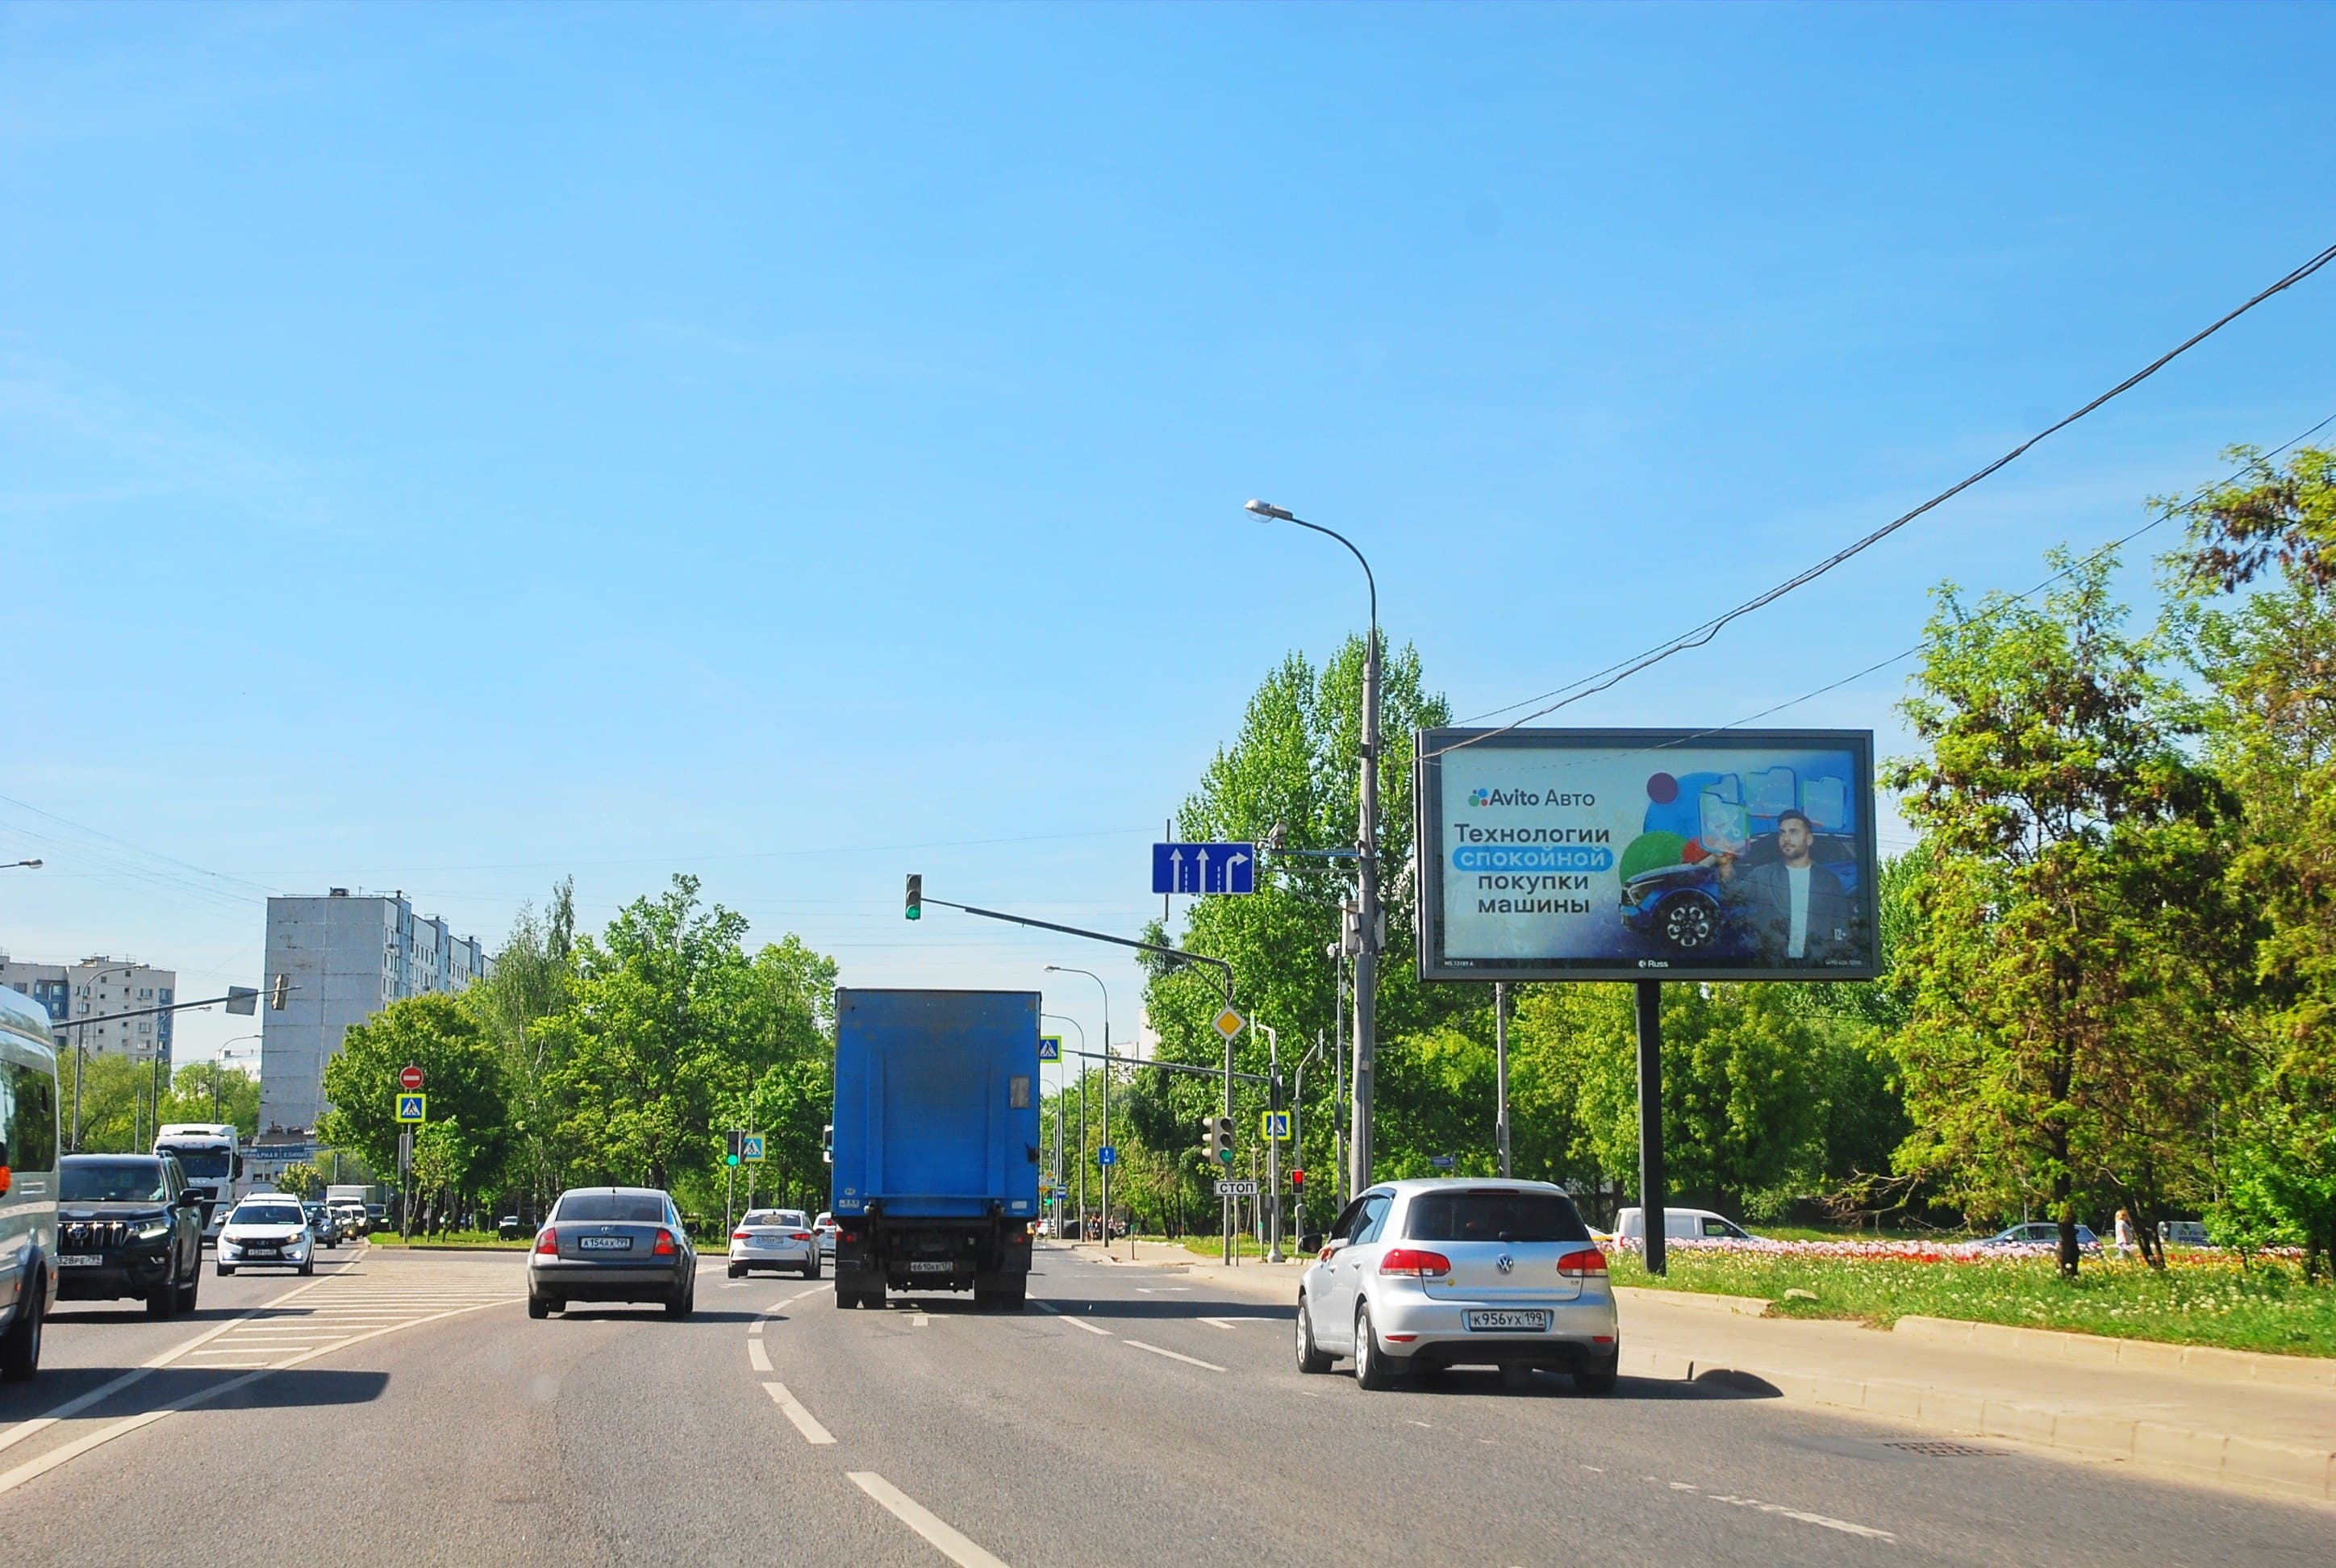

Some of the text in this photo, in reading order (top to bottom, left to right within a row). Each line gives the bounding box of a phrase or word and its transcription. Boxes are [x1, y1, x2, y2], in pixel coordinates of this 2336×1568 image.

[1490, 789, 1596, 807] Avito Авто
[1454, 823, 1610, 843] Технологии
[1460, 845, 1605, 866] спокойной
[1478, 875, 1589, 895] покупки
[1478, 899, 1590, 914] машины
[1647, 959, 1669, 968] Russ
[1220, 1182, 1254, 1194] СТОП
